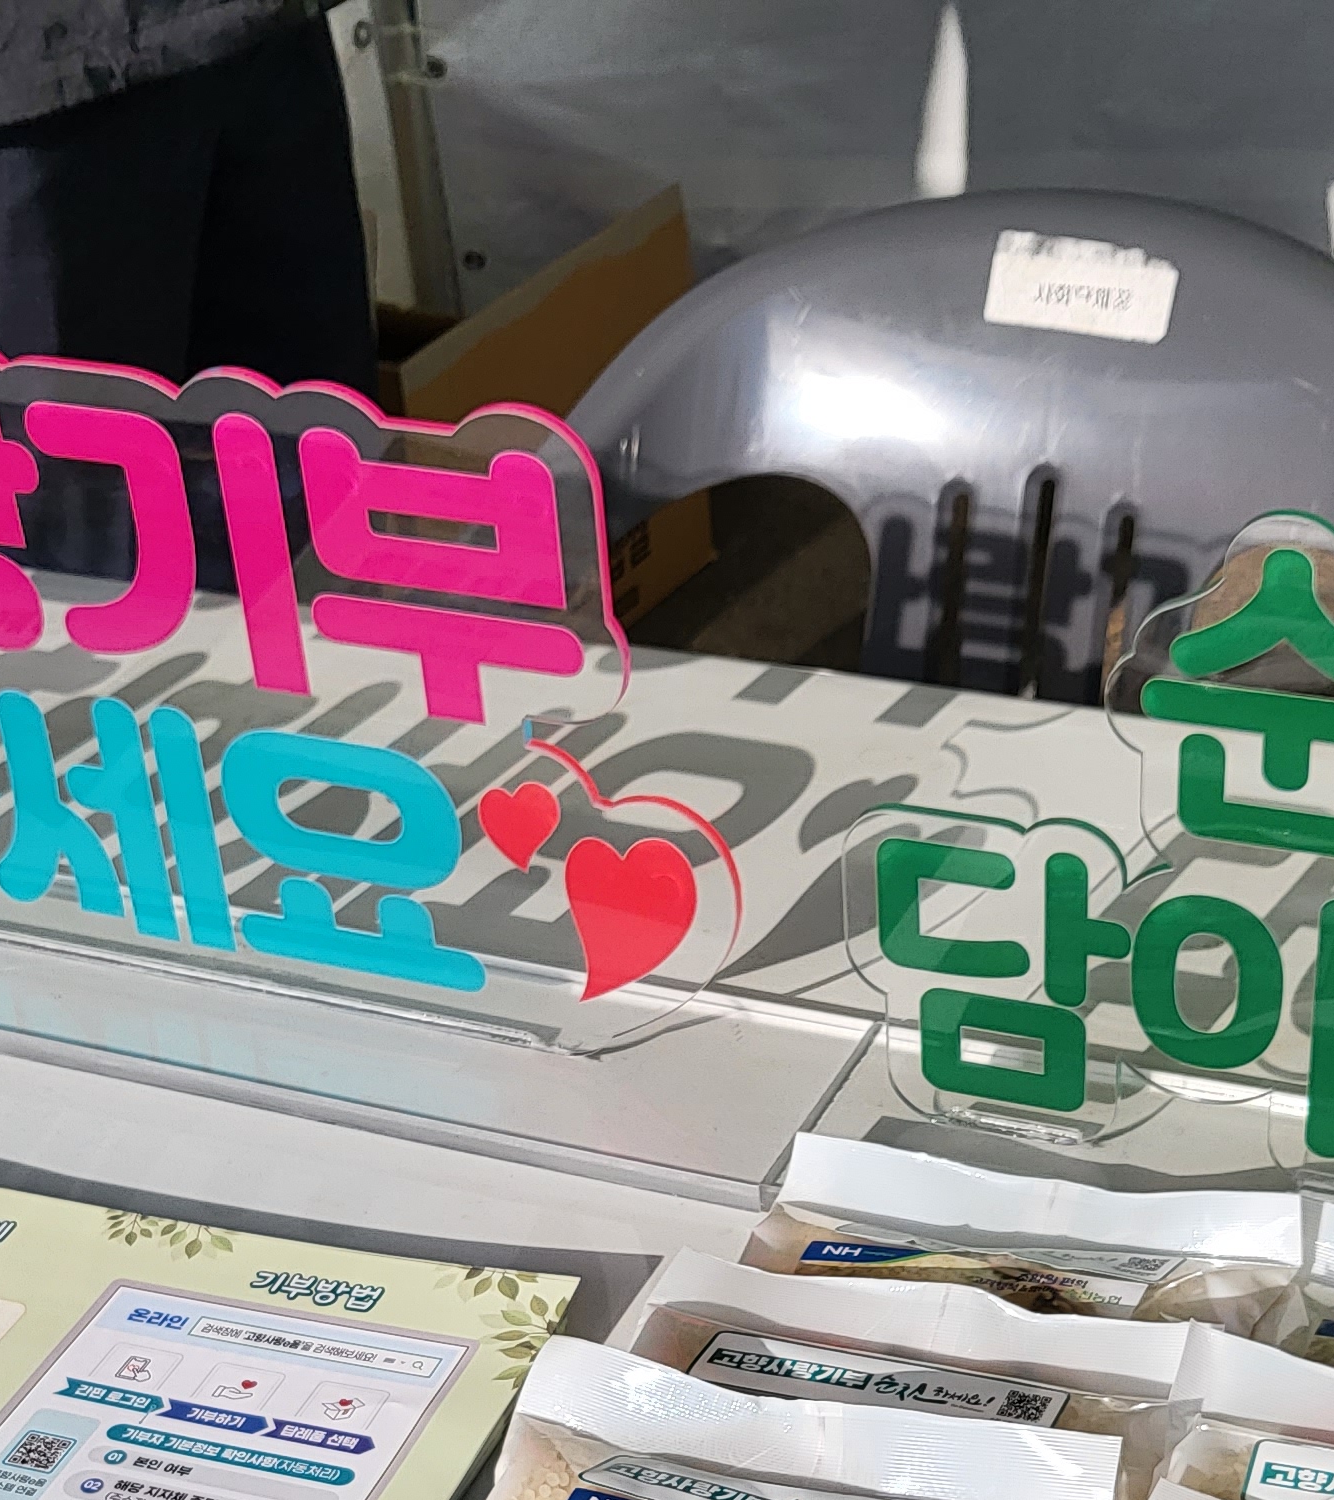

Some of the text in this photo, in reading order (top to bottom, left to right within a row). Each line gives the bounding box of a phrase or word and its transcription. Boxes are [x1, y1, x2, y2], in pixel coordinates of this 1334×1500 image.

[820, 1244, 864, 1258] NH
[250, 1270, 385, 1312] 기부방법
[127, 1307, 190, 1330] 온라인
[201, 1322, 243, 1341] 검색창에
[710, 1349, 871, 1389] 고향사랑기부
[74, 1383, 151, 1409] 간편 로그인
[186, 1407, 247, 1429] 기부하기
[122, 1427, 167, 1446] 기부자
[168, 1436, 221, 1458] 기본정보
[280, 1424, 360, 1450] 답례품 선택
[107, 1452, 194, 1477] 01 본인 여부
[14, 1485, 37, 1497] 연결
[83, 1480, 101, 1491] 02
[113, 1479, 145, 1494] 해당
